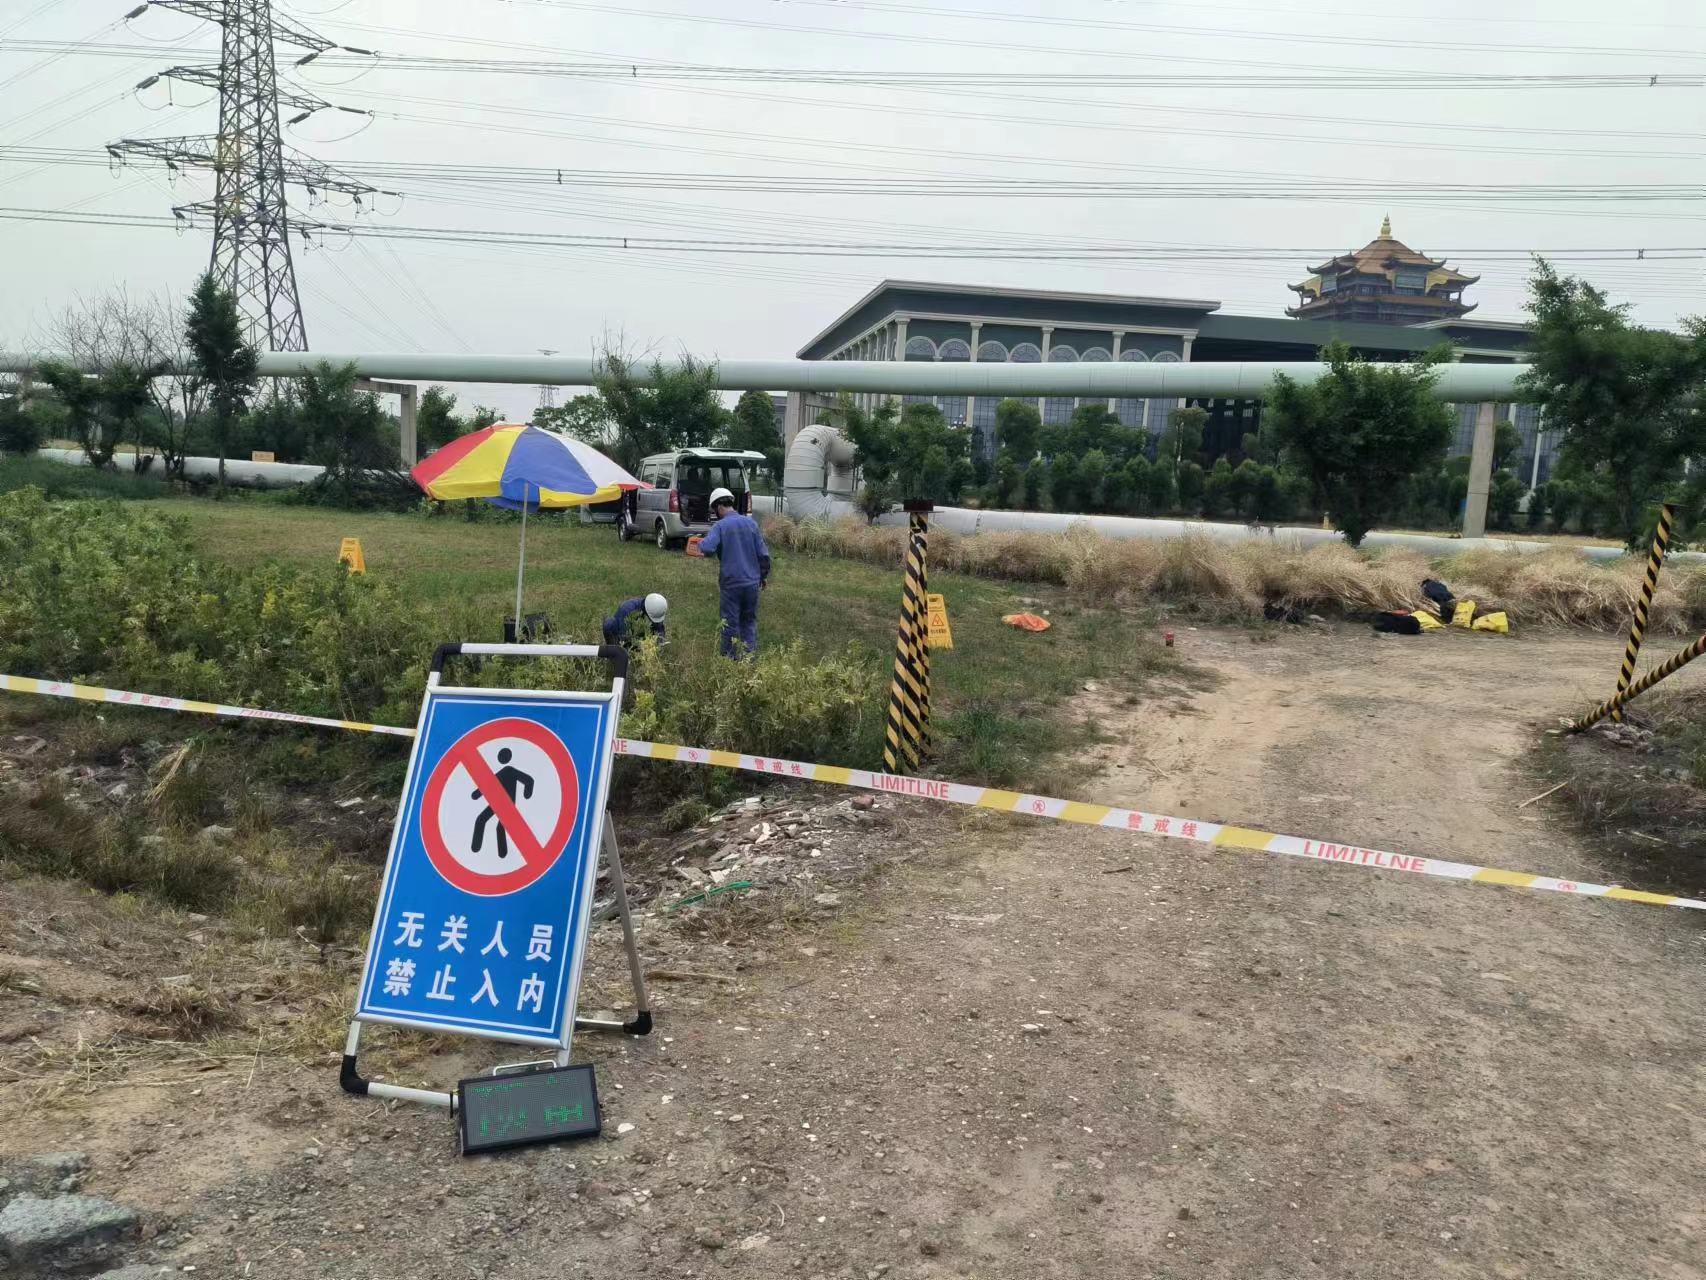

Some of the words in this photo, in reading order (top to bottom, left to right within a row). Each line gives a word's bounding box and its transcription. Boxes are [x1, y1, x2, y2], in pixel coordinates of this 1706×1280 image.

[753, 757, 803, 777] 警戒线
[870, 773, 951, 800] LIMITLNE
[1302, 840, 1427, 872] LIMITLNE
[393, 911, 554, 963] 无关人员
[382, 957, 546, 1014] 禁止入内
